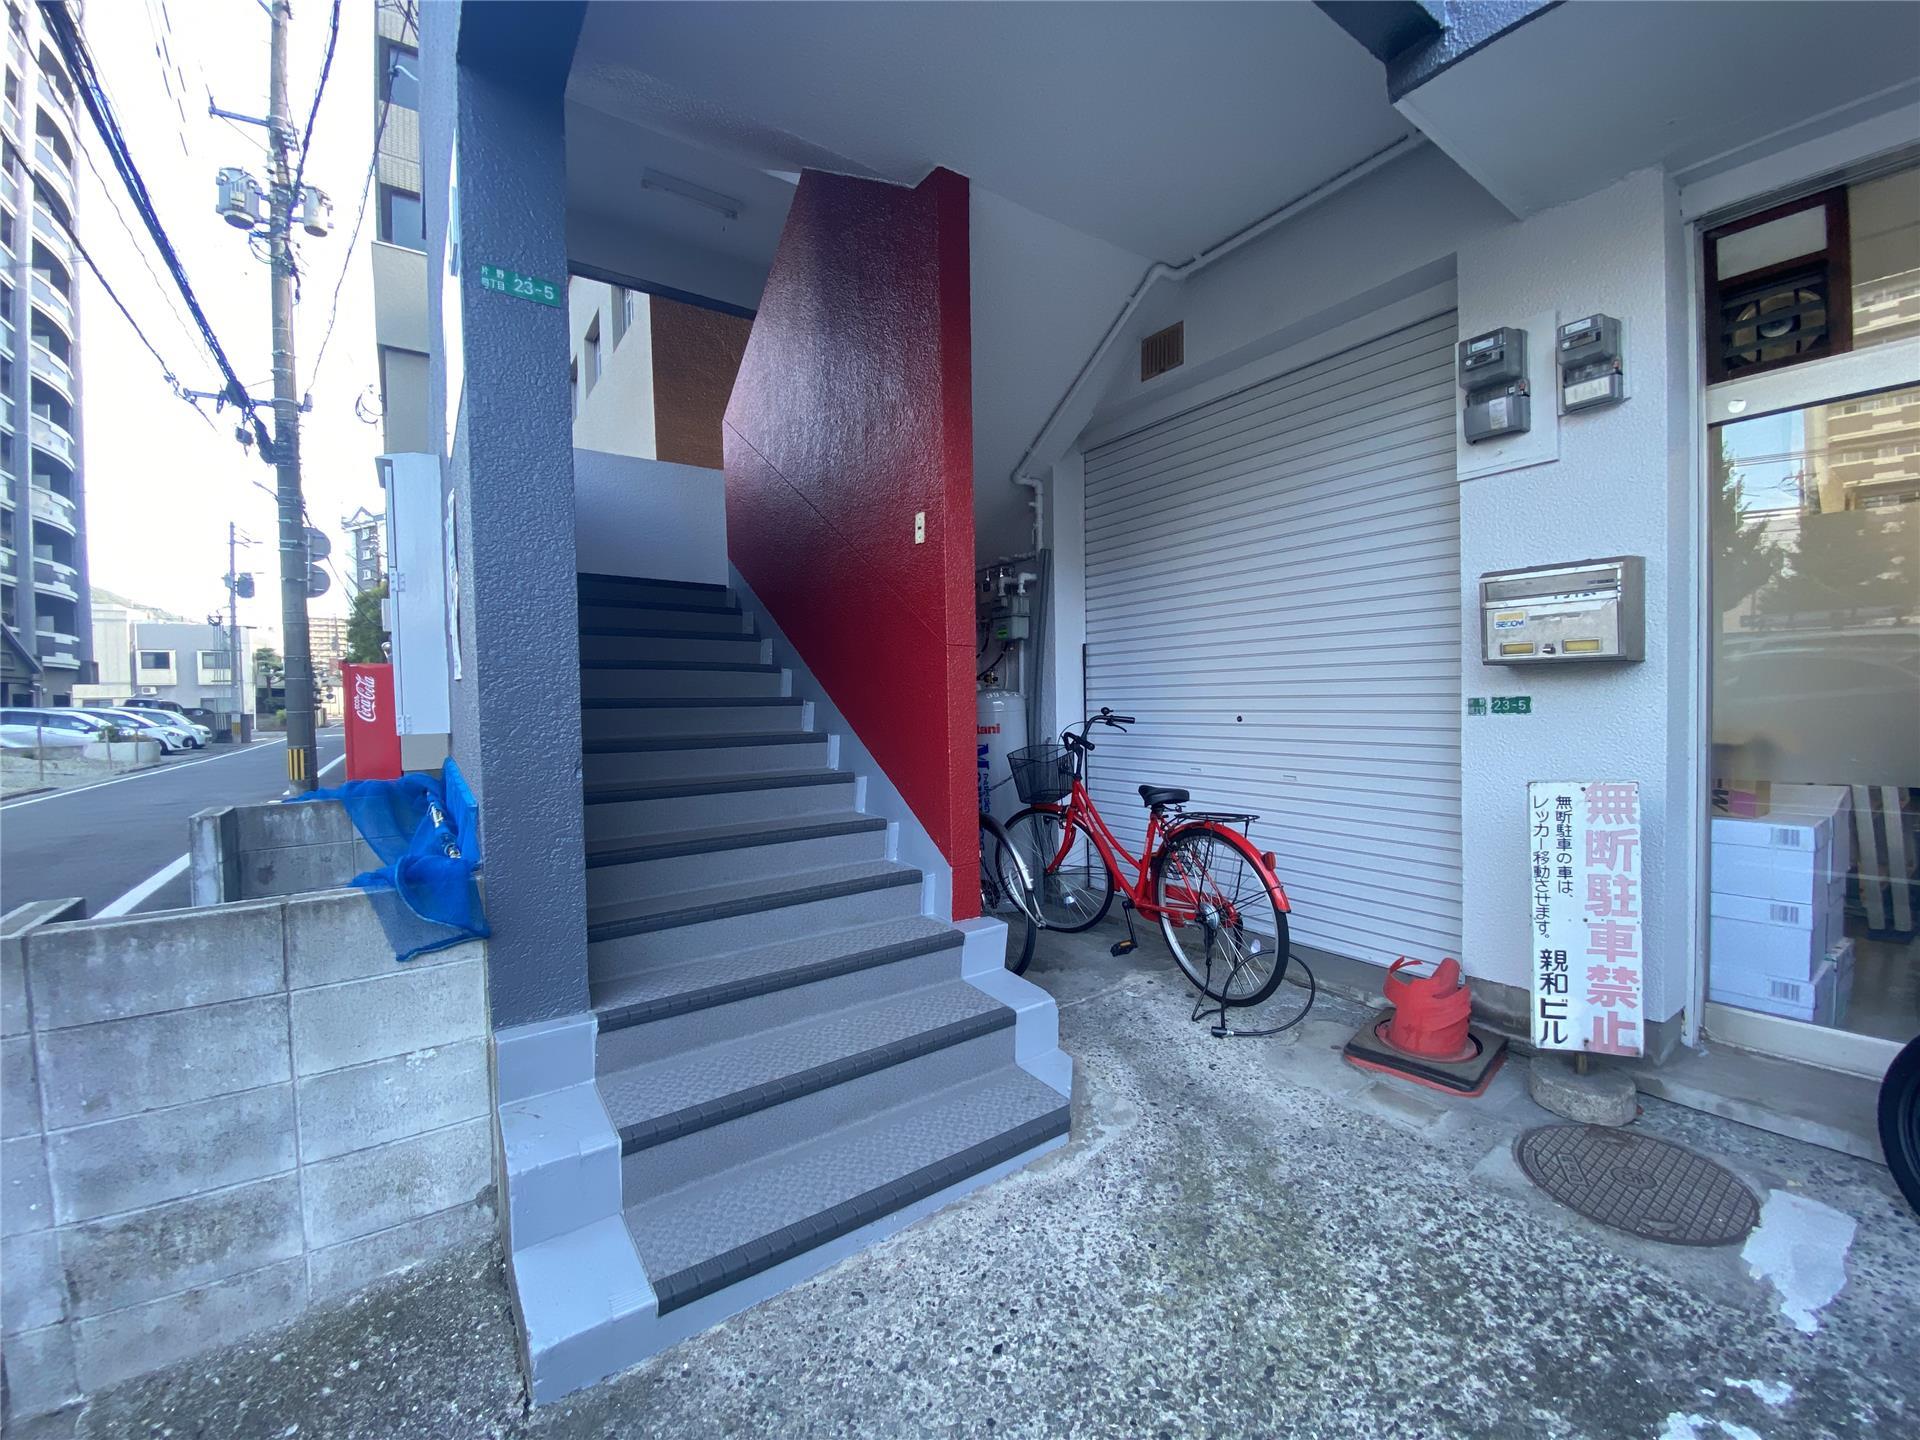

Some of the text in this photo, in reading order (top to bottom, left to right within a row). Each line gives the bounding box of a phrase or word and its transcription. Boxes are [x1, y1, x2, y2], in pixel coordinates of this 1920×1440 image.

[513, 278, 555, 300] 23-5
[1493, 699, 1527, 711] 23-5
[1532, 794, 1551, 939] レッカー移動させます。
[1555, 794, 1574, 898] 無断駐車の車は、
[1584, 780, 1640, 1056] 無断駐車禁止
[1539, 948, 1568, 1044] 親和ビル
